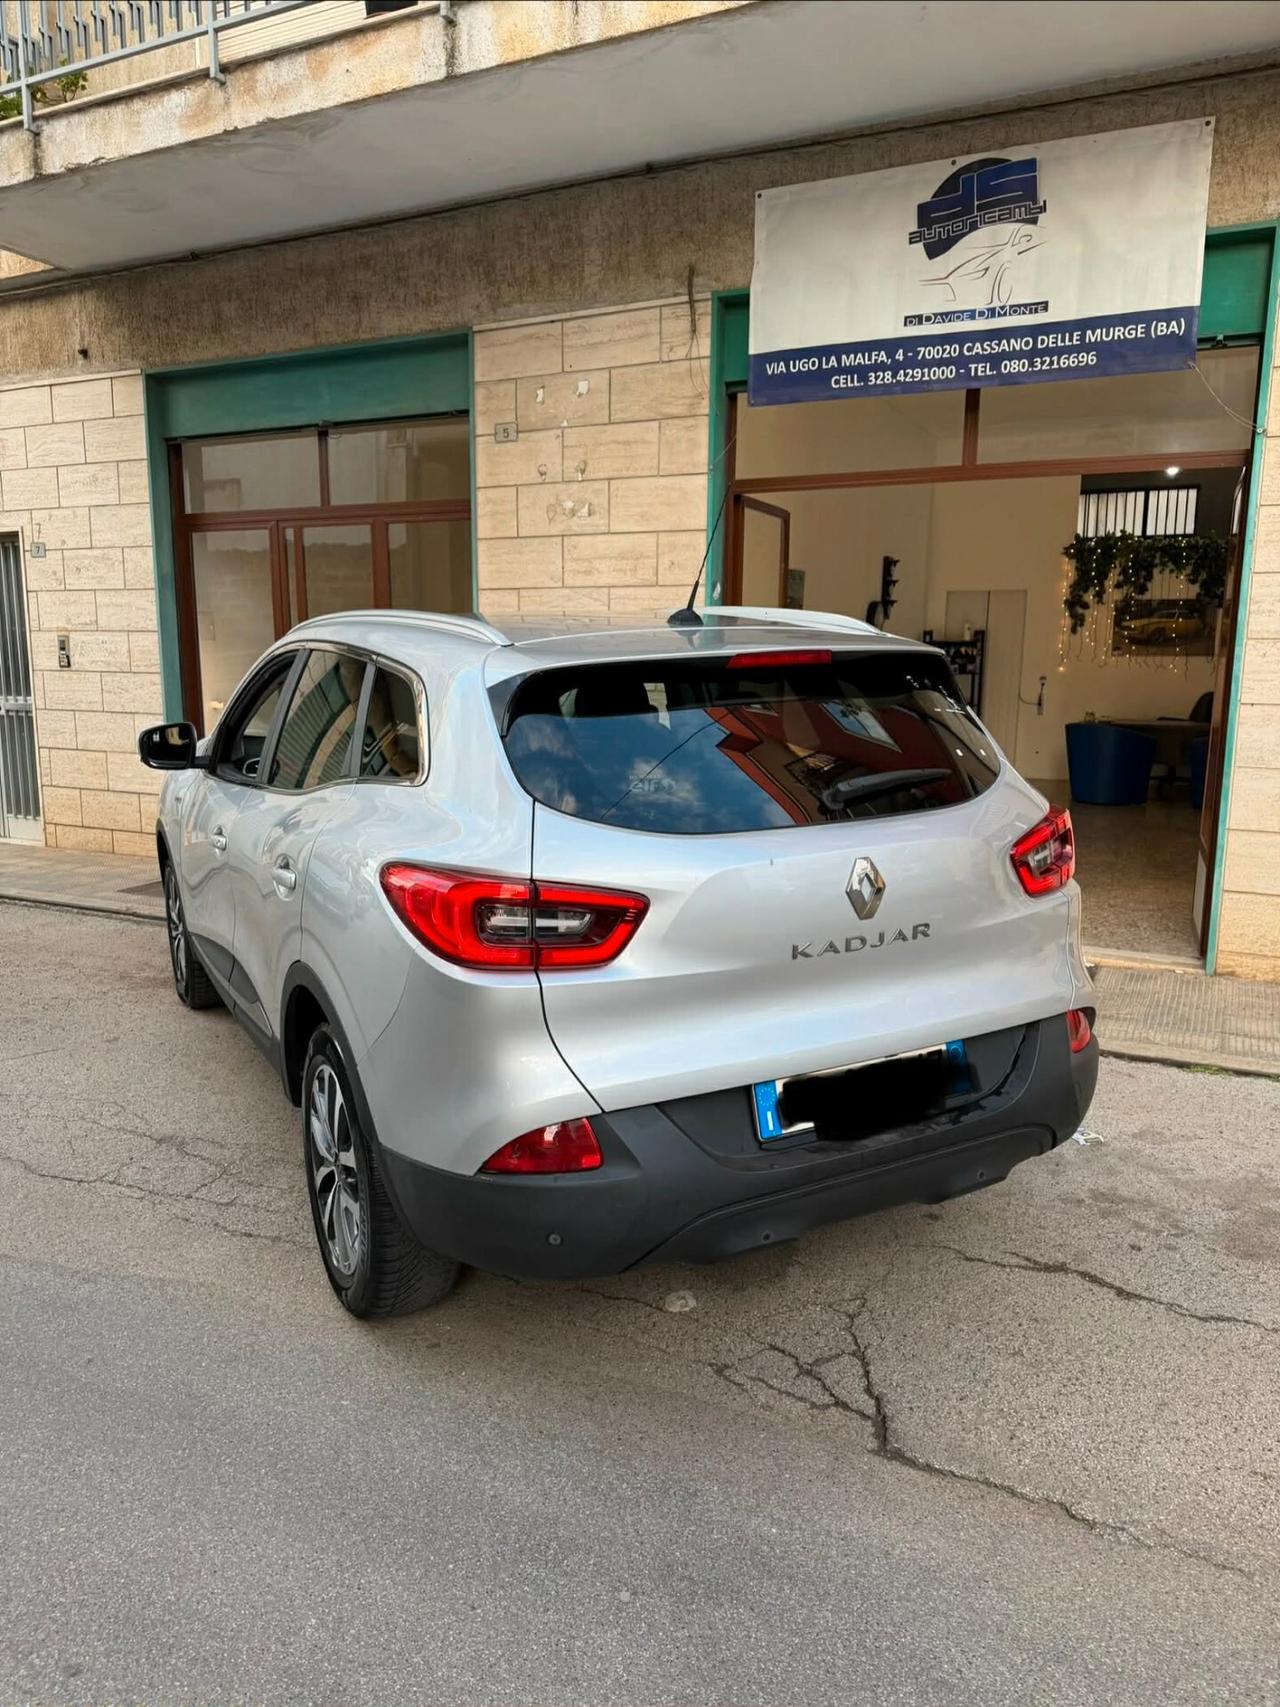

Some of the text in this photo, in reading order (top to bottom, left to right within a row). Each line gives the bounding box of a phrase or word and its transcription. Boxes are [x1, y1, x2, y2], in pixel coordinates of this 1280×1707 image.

[766, 363, 787, 376] VIA
[789, 357, 819, 373] UGO
[822, 356, 838, 370] LA
[841, 351, 892, 367] MALFA,
[895, 349, 904, 362] 4
[917, 344, 959, 361] 70020
[963, 336, 1034, 357] CASSANO
[1037, 331, 1082, 349] DELLE
[1085, 323, 1147, 343] MURGE
[1150, 317, 1185, 339] (BA)
[831, 374, 865, 389] CELL.
[867, 365, 956, 386] 328.4291000
[968, 362, 997, 378] TEL.
[1000, 351, 1097, 374] 080.3216696
[502, 427, 510, 439] 5
[791, 922, 931, 960] KADJAR
